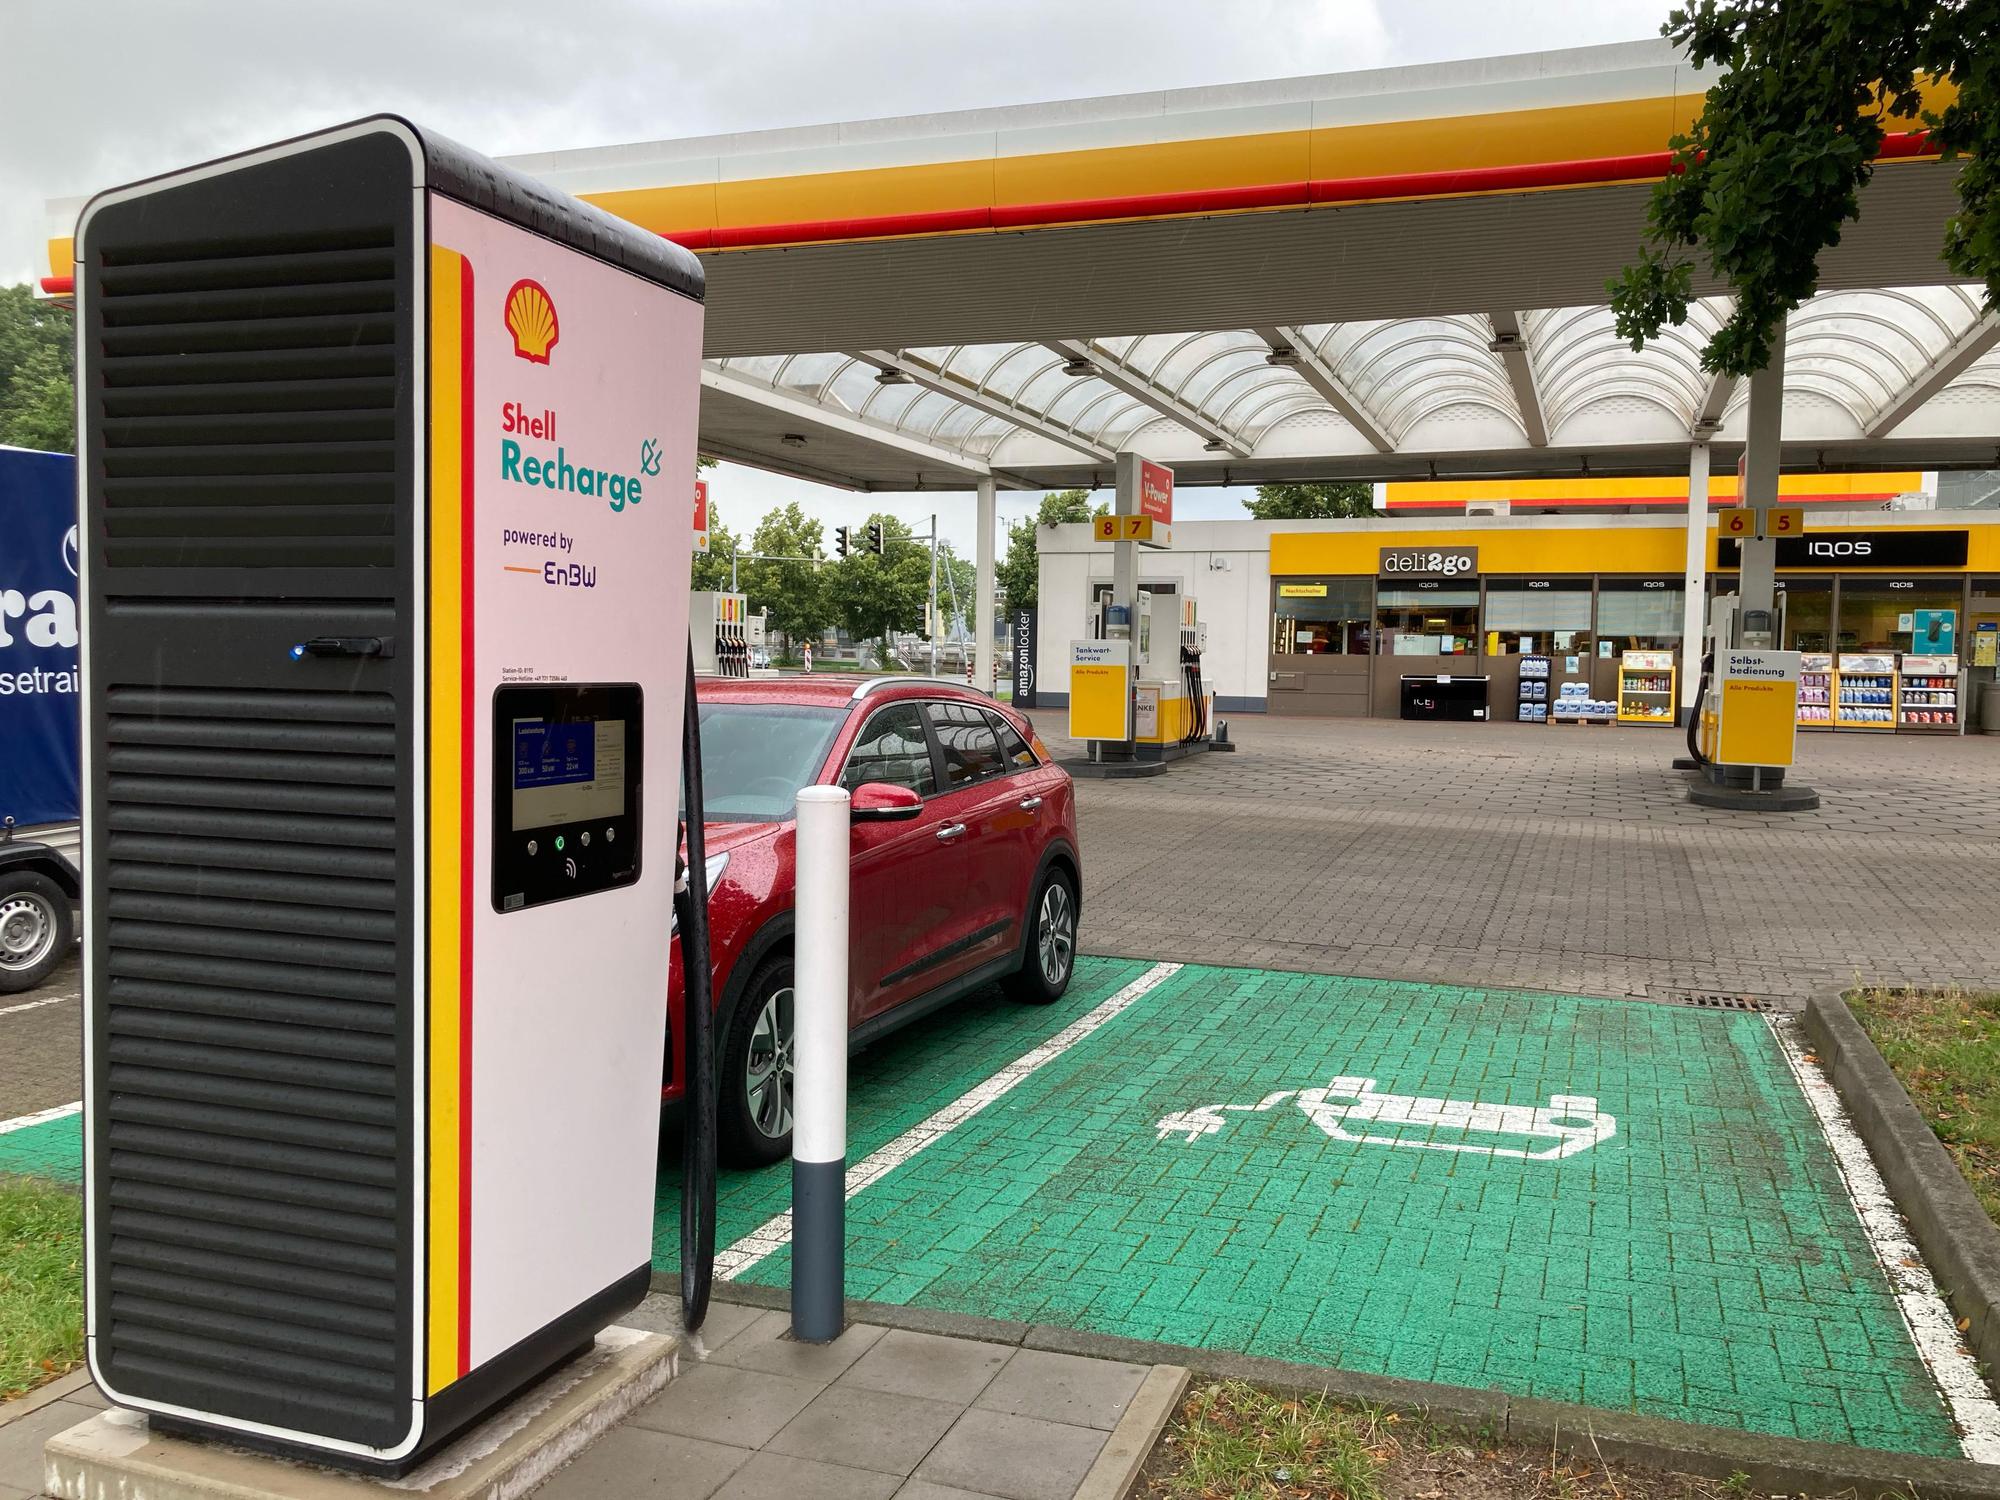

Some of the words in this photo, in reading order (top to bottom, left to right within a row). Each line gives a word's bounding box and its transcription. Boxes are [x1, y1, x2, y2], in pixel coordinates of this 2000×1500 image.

[502, 402, 556, 442] Shell
[501, 438, 642, 513] Recharge
[1144, 481, 1168, 505] V-Power
[1103, 521, 1113, 536] 8
[1131, 520, 1142, 535] 7
[1730, 515, 1744, 531] 6
[1777, 515, 1790, 531] 5
[503, 529, 557, 548] powered
[560, 532, 573, 554] by
[1808, 541, 1872, 558] IQOS
[1385, 552, 1472, 576] deli2go
[544, 561, 596, 588] EnBW
[1889, 581, 1914, 589] IQOS
[1016, 610, 1030, 697] amazonlocker
[1075, 654, 1101, 662] Service
[1730, 656, 1765, 665] Selbst-
[1729, 665, 1785, 678] bedienung
